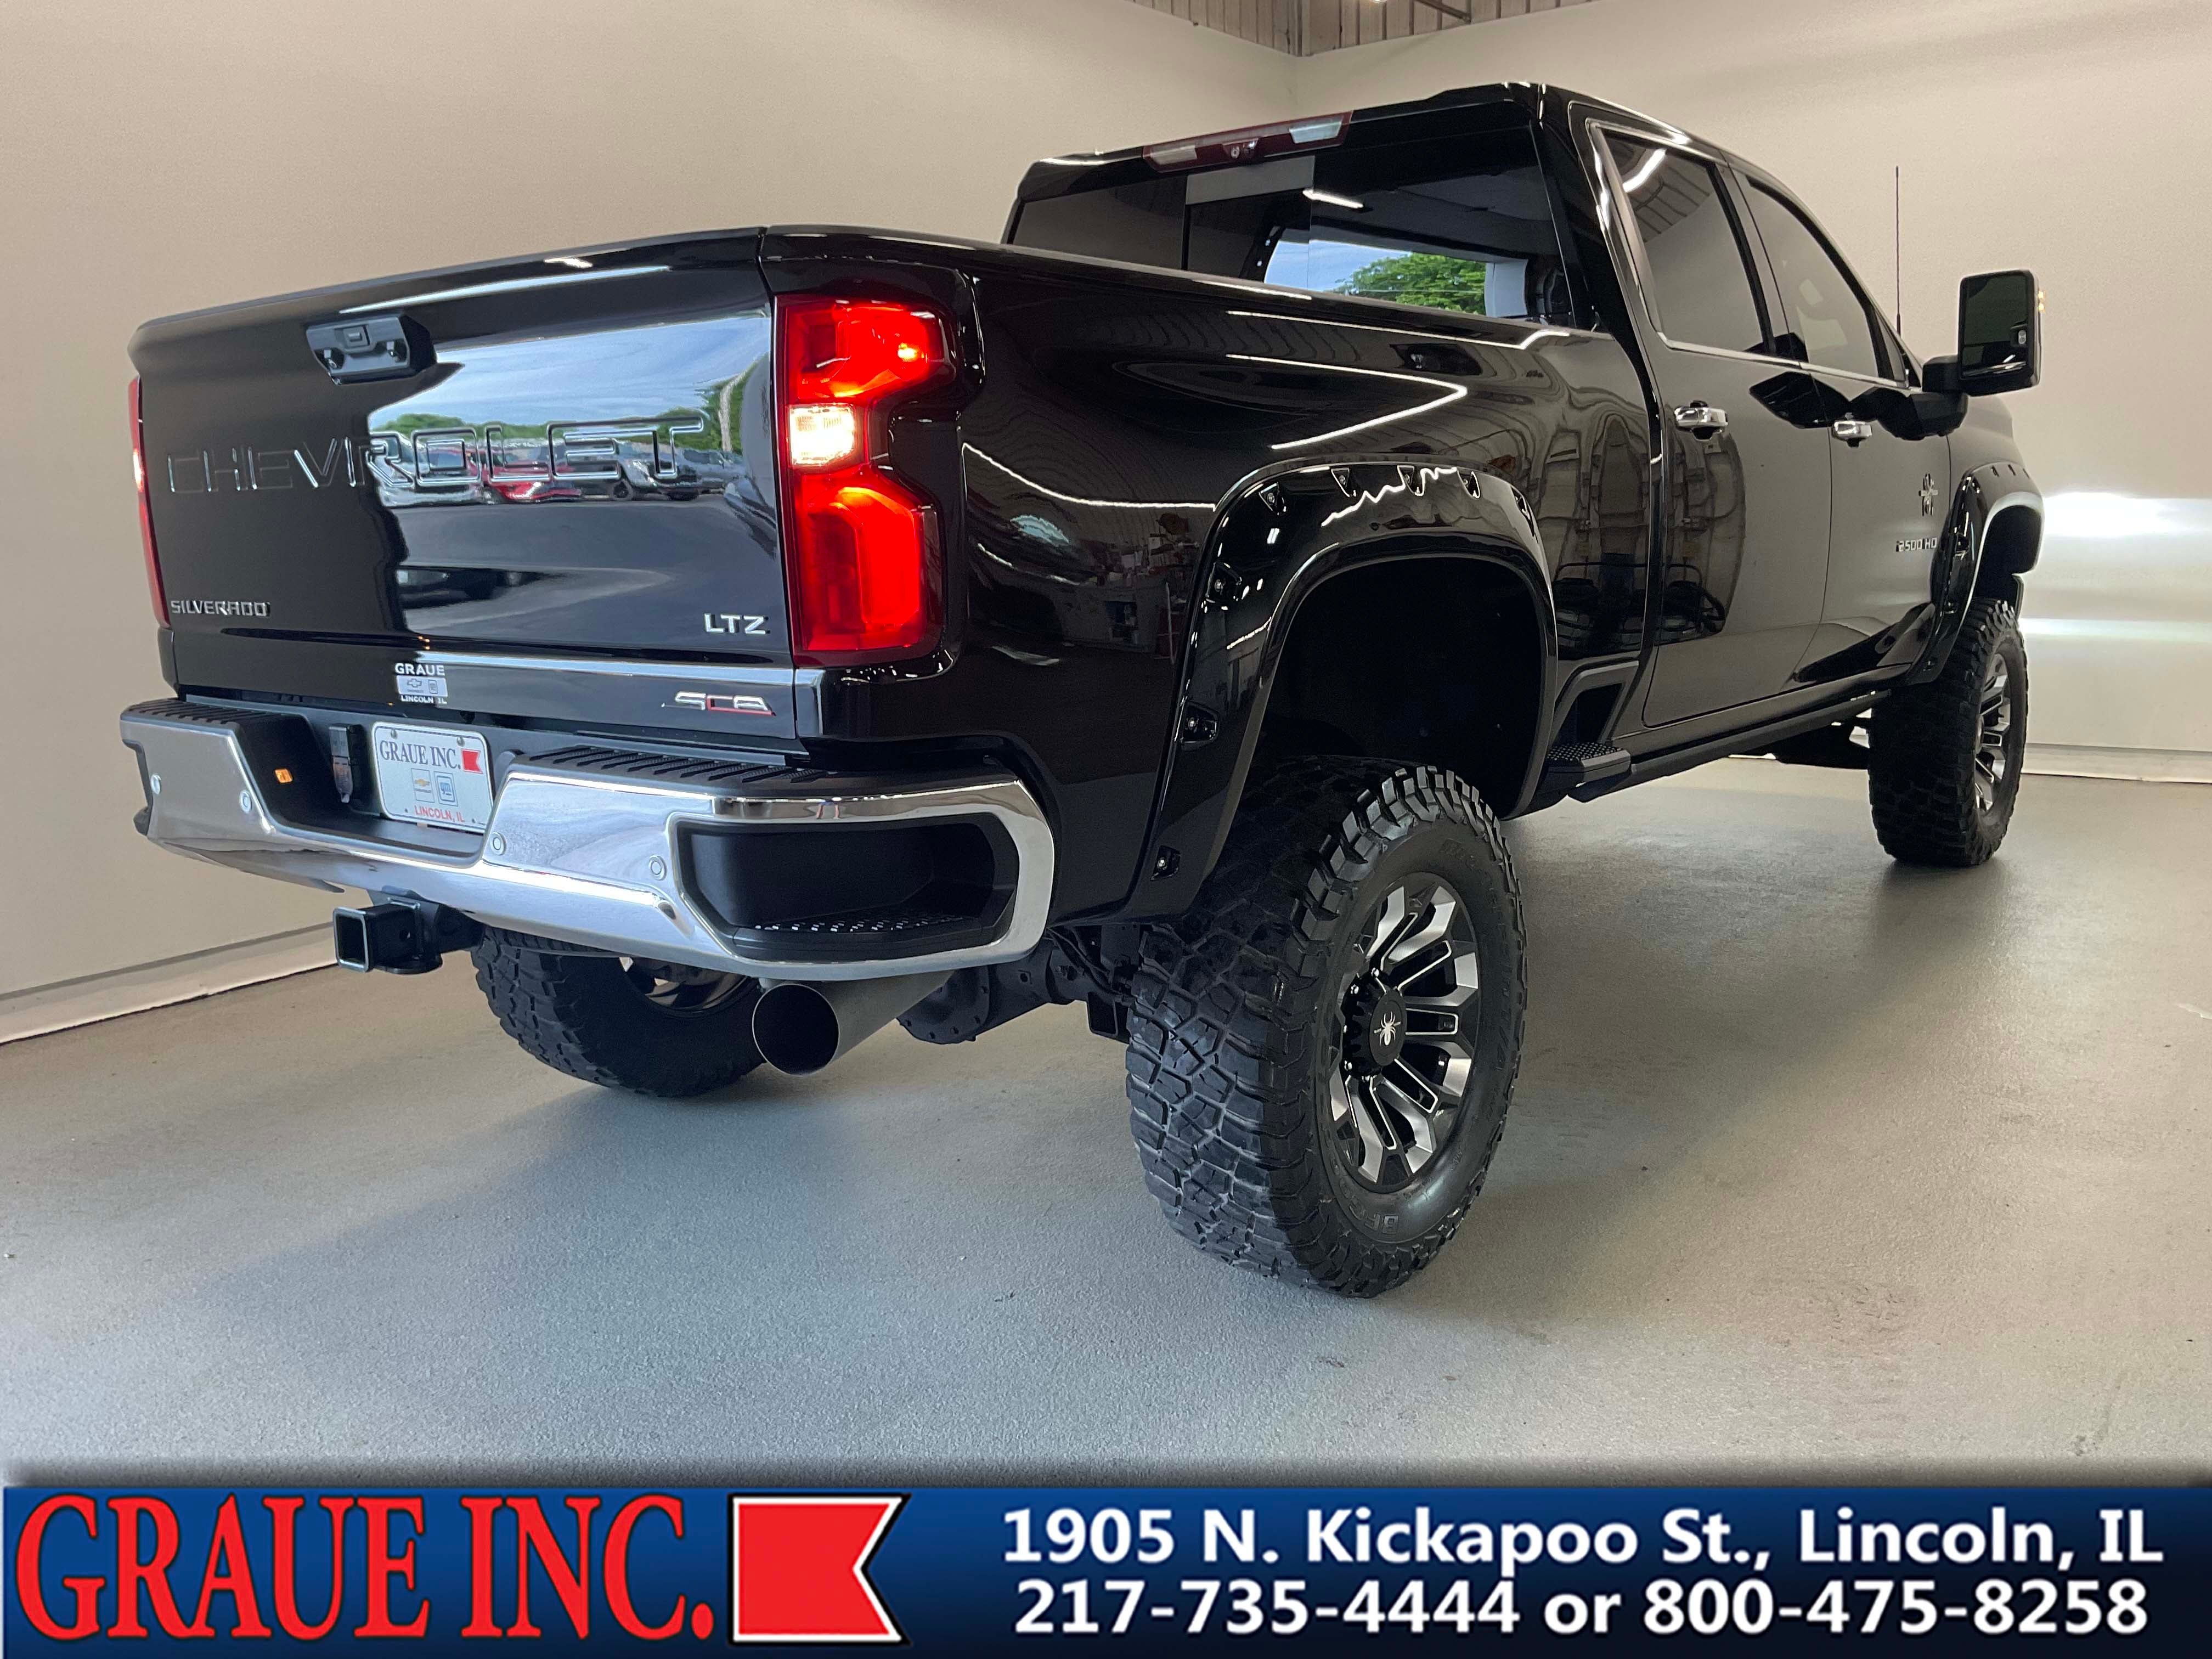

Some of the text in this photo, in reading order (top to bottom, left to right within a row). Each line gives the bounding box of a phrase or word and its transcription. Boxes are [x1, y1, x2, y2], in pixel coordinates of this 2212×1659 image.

[167, 415, 704, 493] CHEVROLET
[1898, 537, 1938, 552] 2500 HD
[170, 600, 270, 617] SILVERADO
[704, 613, 766, 634] LTZ
[395, 662, 445, 676] GRAUE
[400, 695, 434, 703] LINCOLN
[380, 740, 461, 769] GRAUE INC.
[414, 805, 465, 822] LINCOLN, IL
